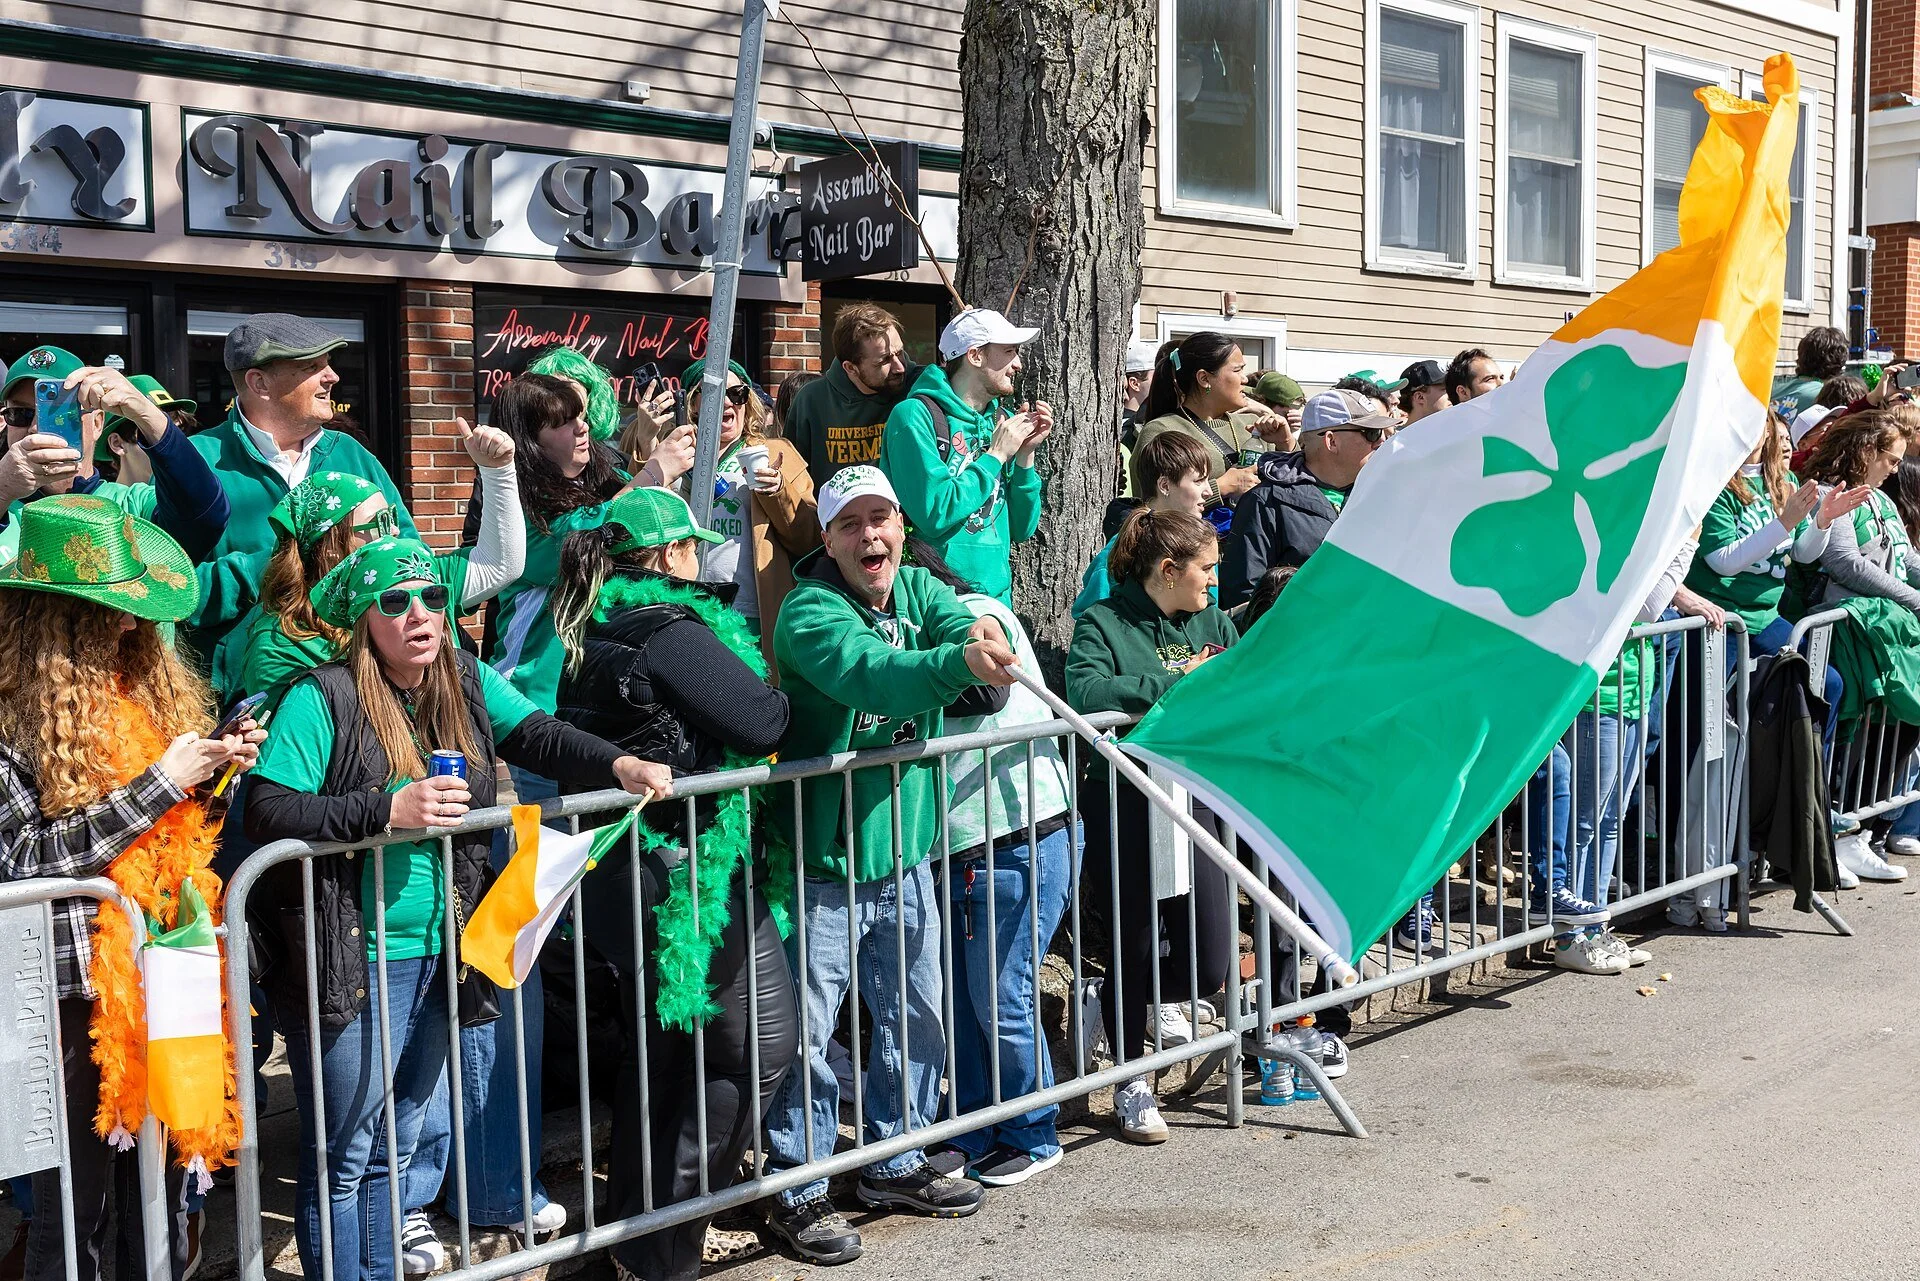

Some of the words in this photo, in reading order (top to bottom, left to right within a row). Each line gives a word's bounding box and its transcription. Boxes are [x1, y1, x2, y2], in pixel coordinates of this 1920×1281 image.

[190, 115, 506, 240] Nail
[810, 161, 893, 215] Assembly
[809, 222, 849, 265] Nail
[856, 216, 894, 262] Bar
[481, 308, 608, 362] Assembly
[616, 315, 680, 360] Nail
[825, 436, 882, 464] VERM
[827, 423, 887, 440] UNIVERSIT
[829, 466, 876, 489] BOSTON
[15, 927, 45, 1030] Police
[22, 1034, 54, 1152] Boston
